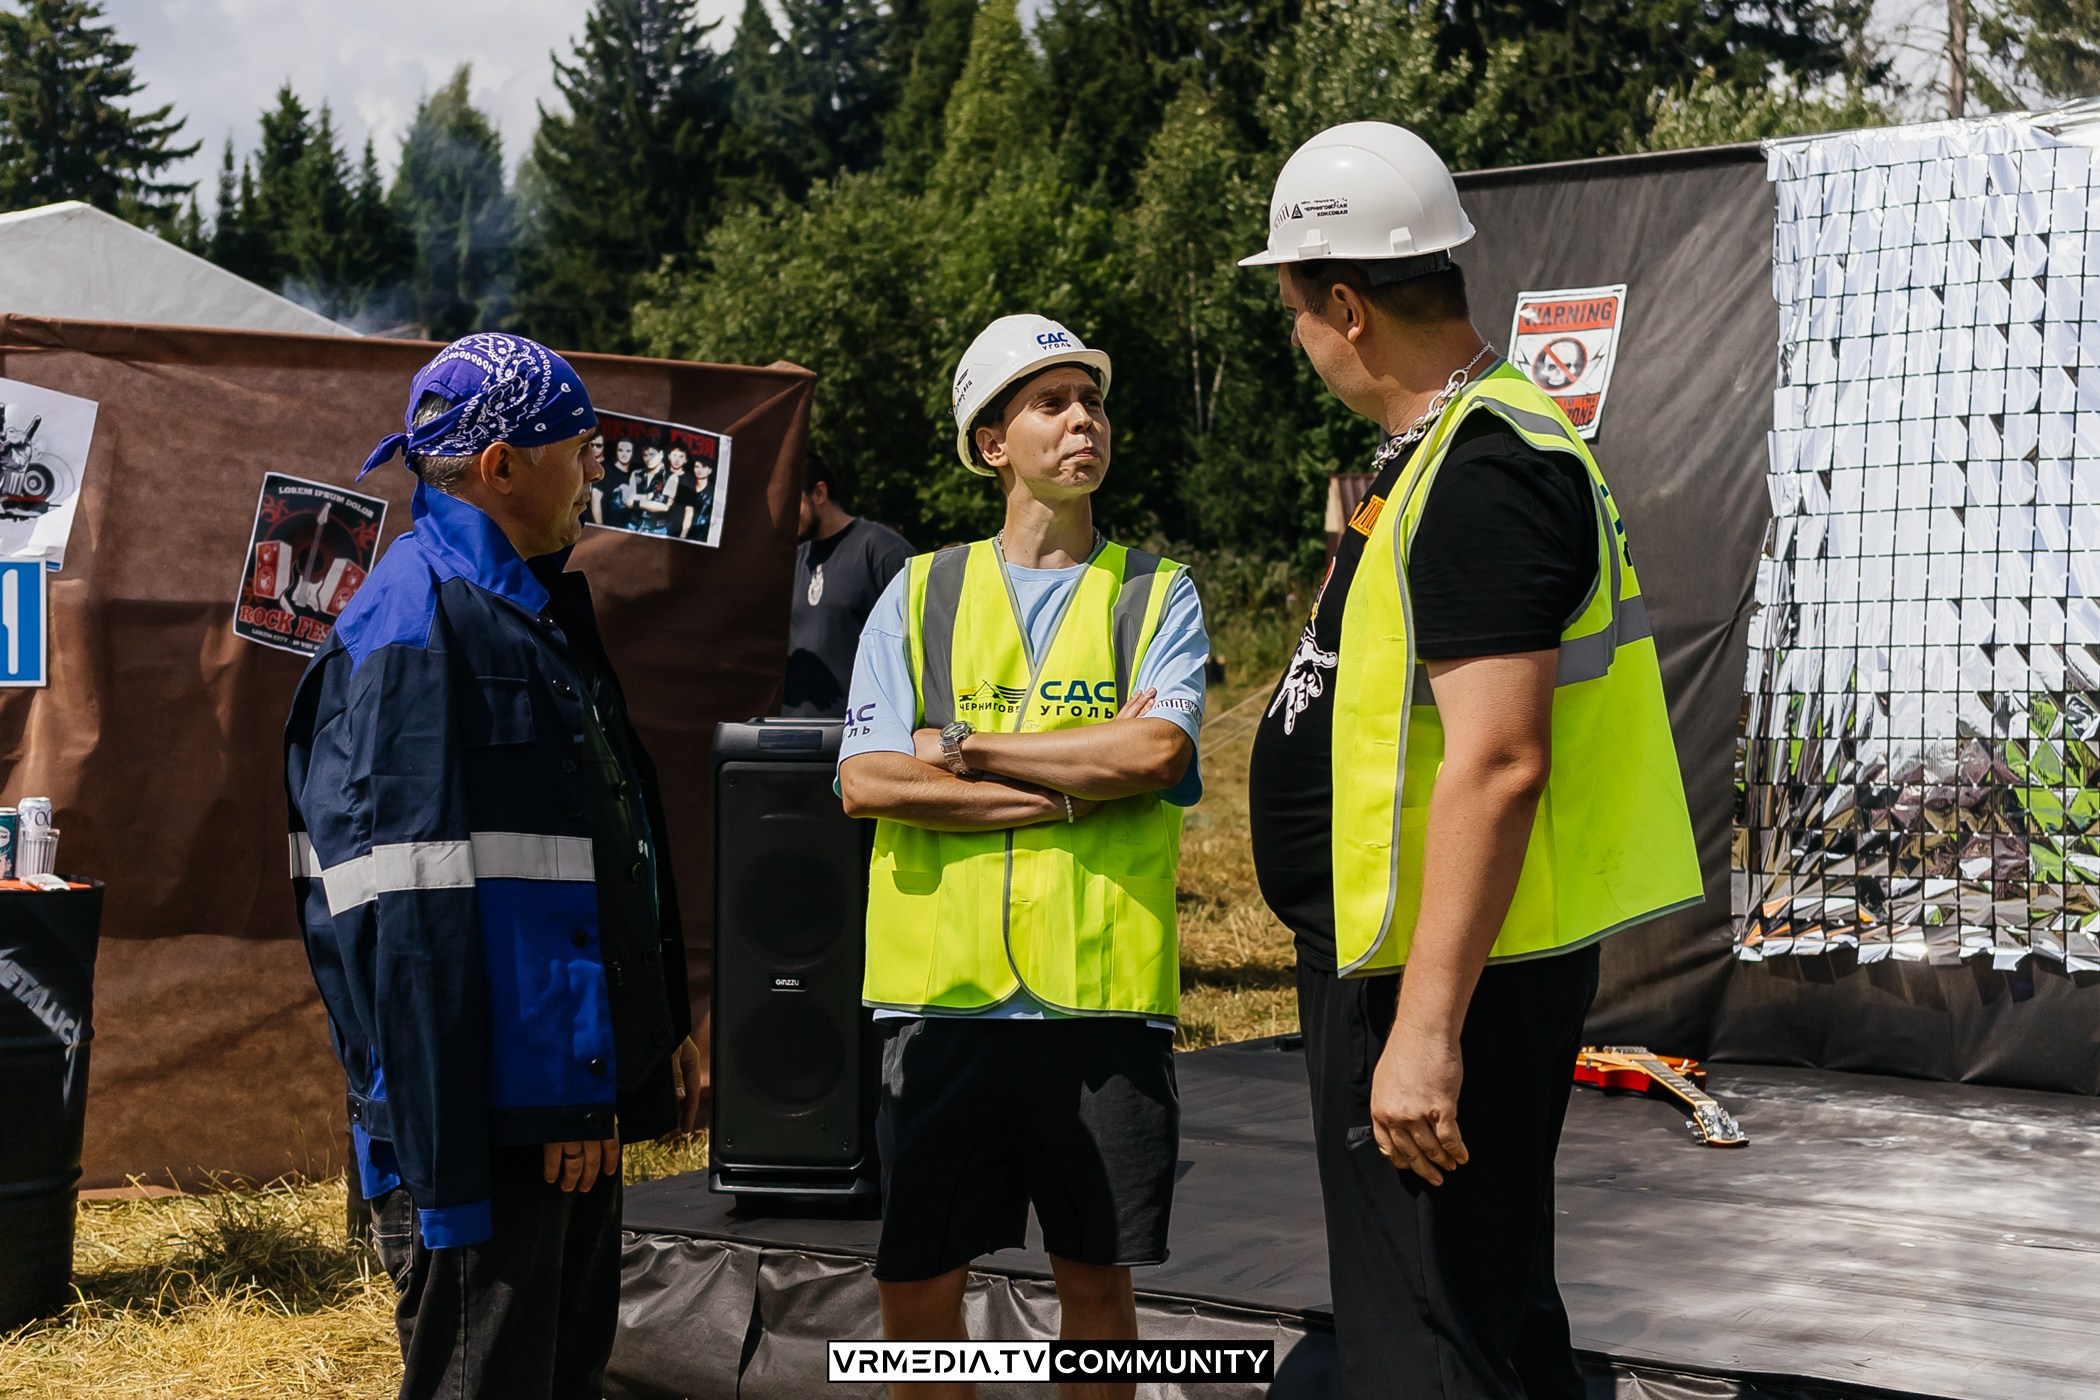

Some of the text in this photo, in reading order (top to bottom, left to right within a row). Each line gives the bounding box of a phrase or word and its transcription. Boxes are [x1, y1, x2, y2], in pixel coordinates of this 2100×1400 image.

[1042, 342, 1071, 350] УГОЛЬ
[278, 486, 375, 519] LOREM IPSUM DOLOR
[239, 606, 293, 634] ROCK
[1040, 680, 1115, 704] СДС
[1040, 705, 1114, 719] УГОЛЬ
